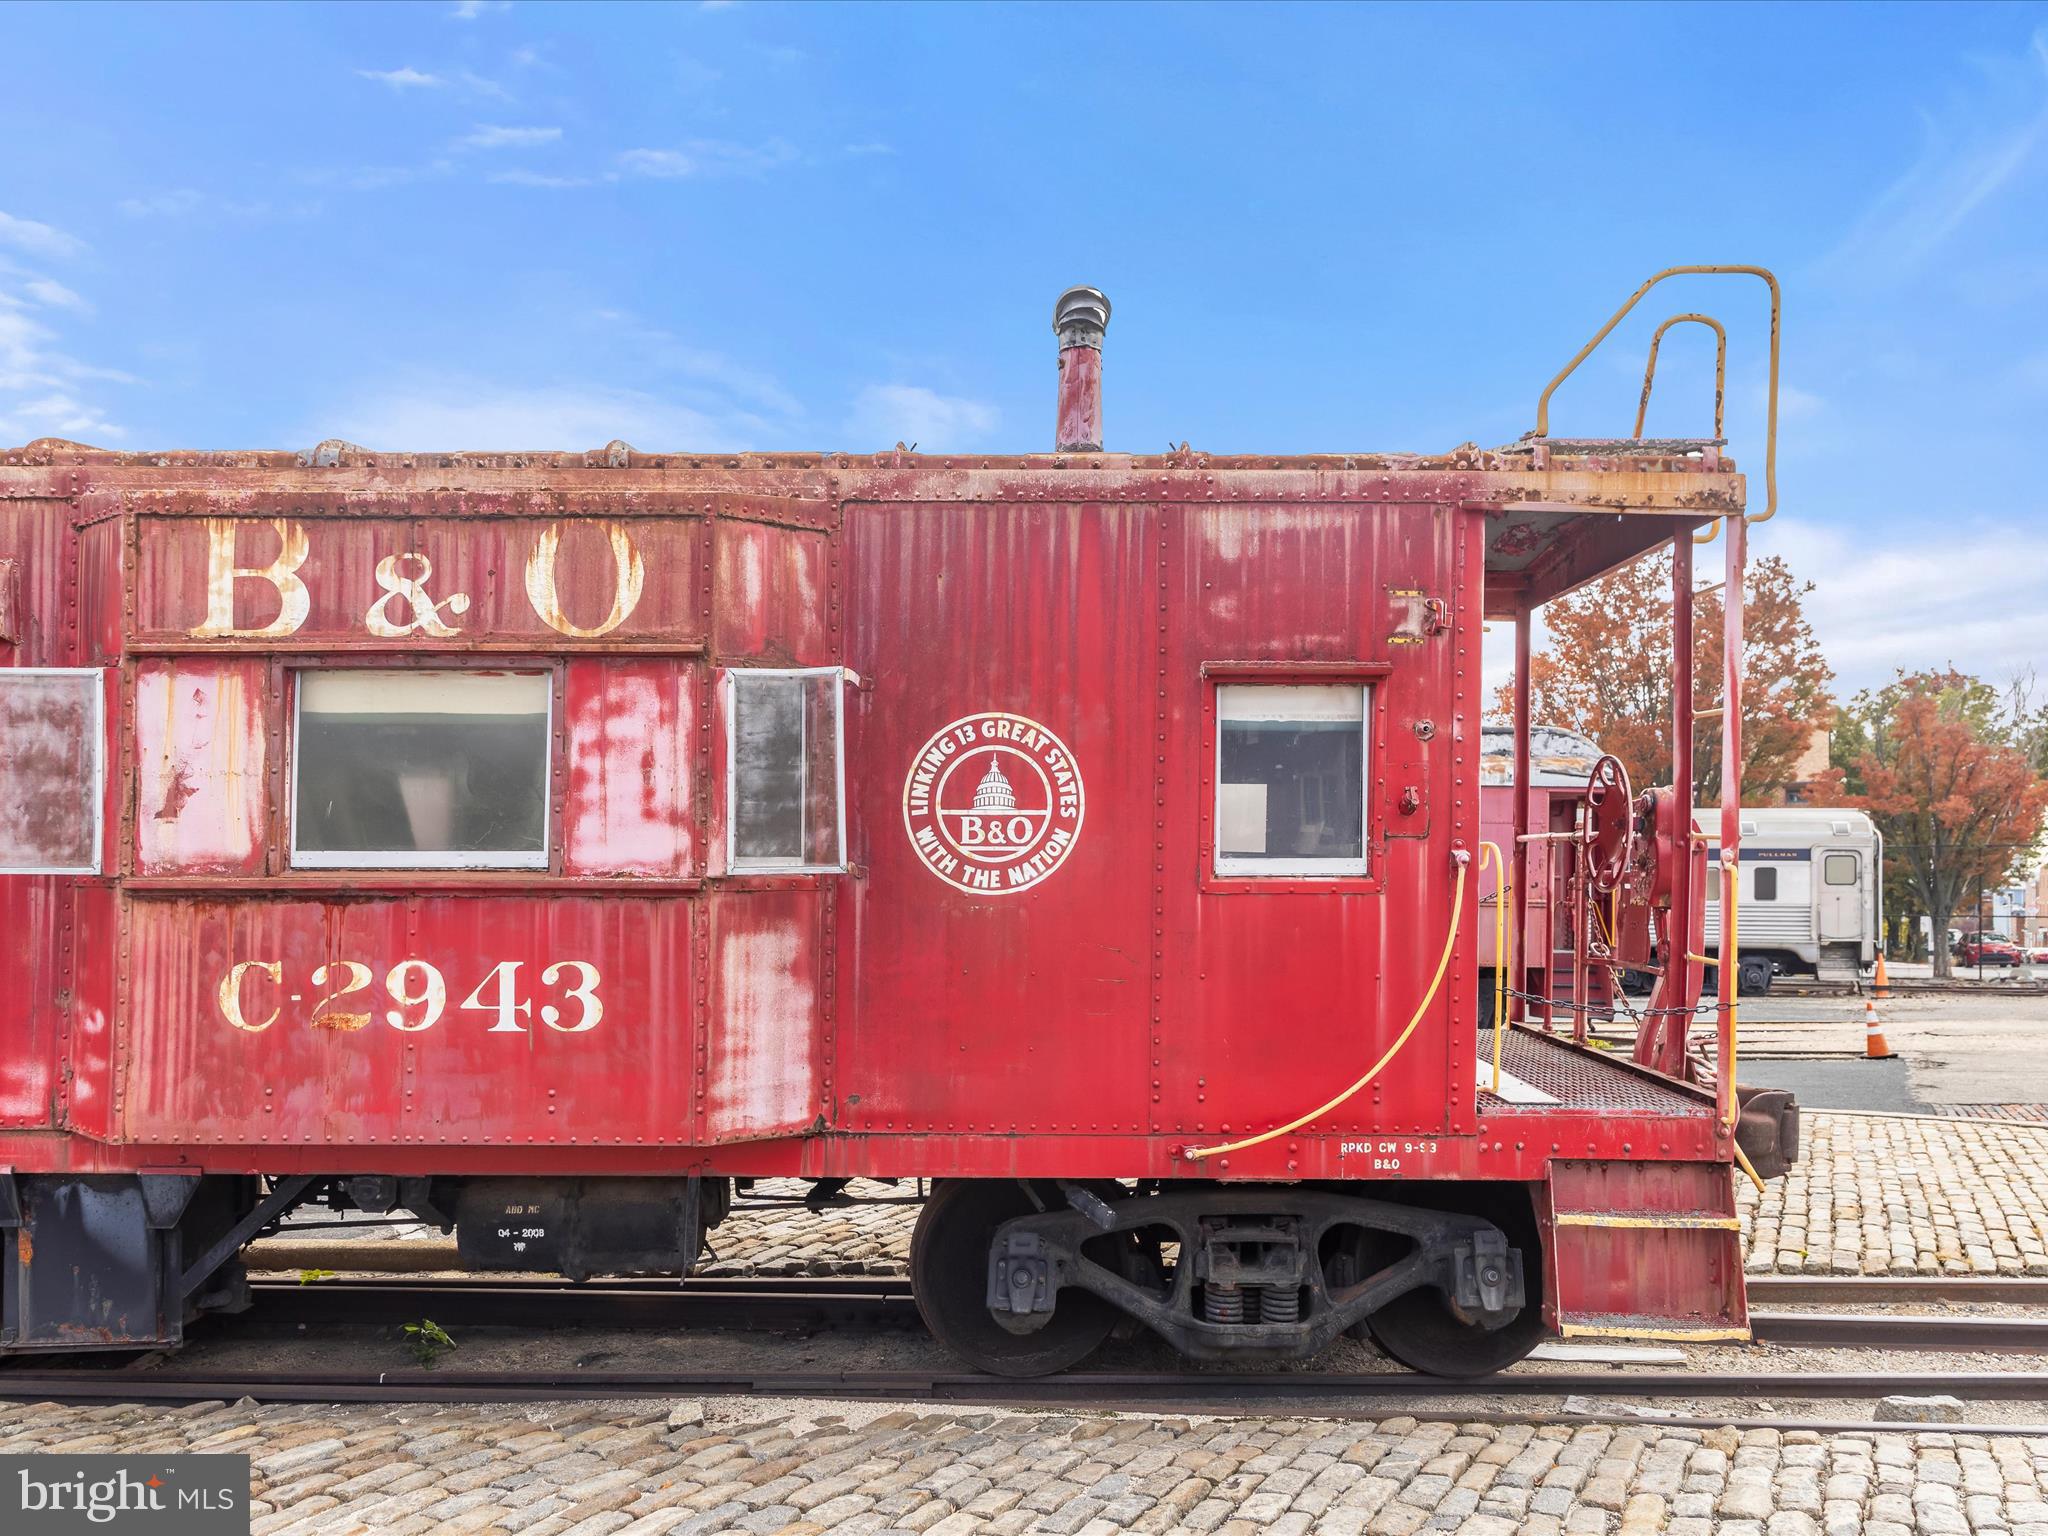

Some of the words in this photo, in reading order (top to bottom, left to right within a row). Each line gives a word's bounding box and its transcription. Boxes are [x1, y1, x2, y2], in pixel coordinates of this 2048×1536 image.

[188, 518, 310, 637] B
[365, 552, 470, 637] &
[525, 518, 645, 638] O
[910, 736, 956, 816] LINKING
[954, 724, 977, 746] 13
[981, 719, 1051, 753] GREAT
[1044, 747, 1078, 819] STATES
[960, 816, 1033, 845] B&O
[915, 825, 959, 874] WITH
[961, 864, 1001, 889] THE
[1008, 827, 1072, 886] NATION
[1340, 1142, 1372, 1153] RPKD
[1378, 1142, 1397, 1153] CW
[1374, 1158, 1400, 1170] B&O
